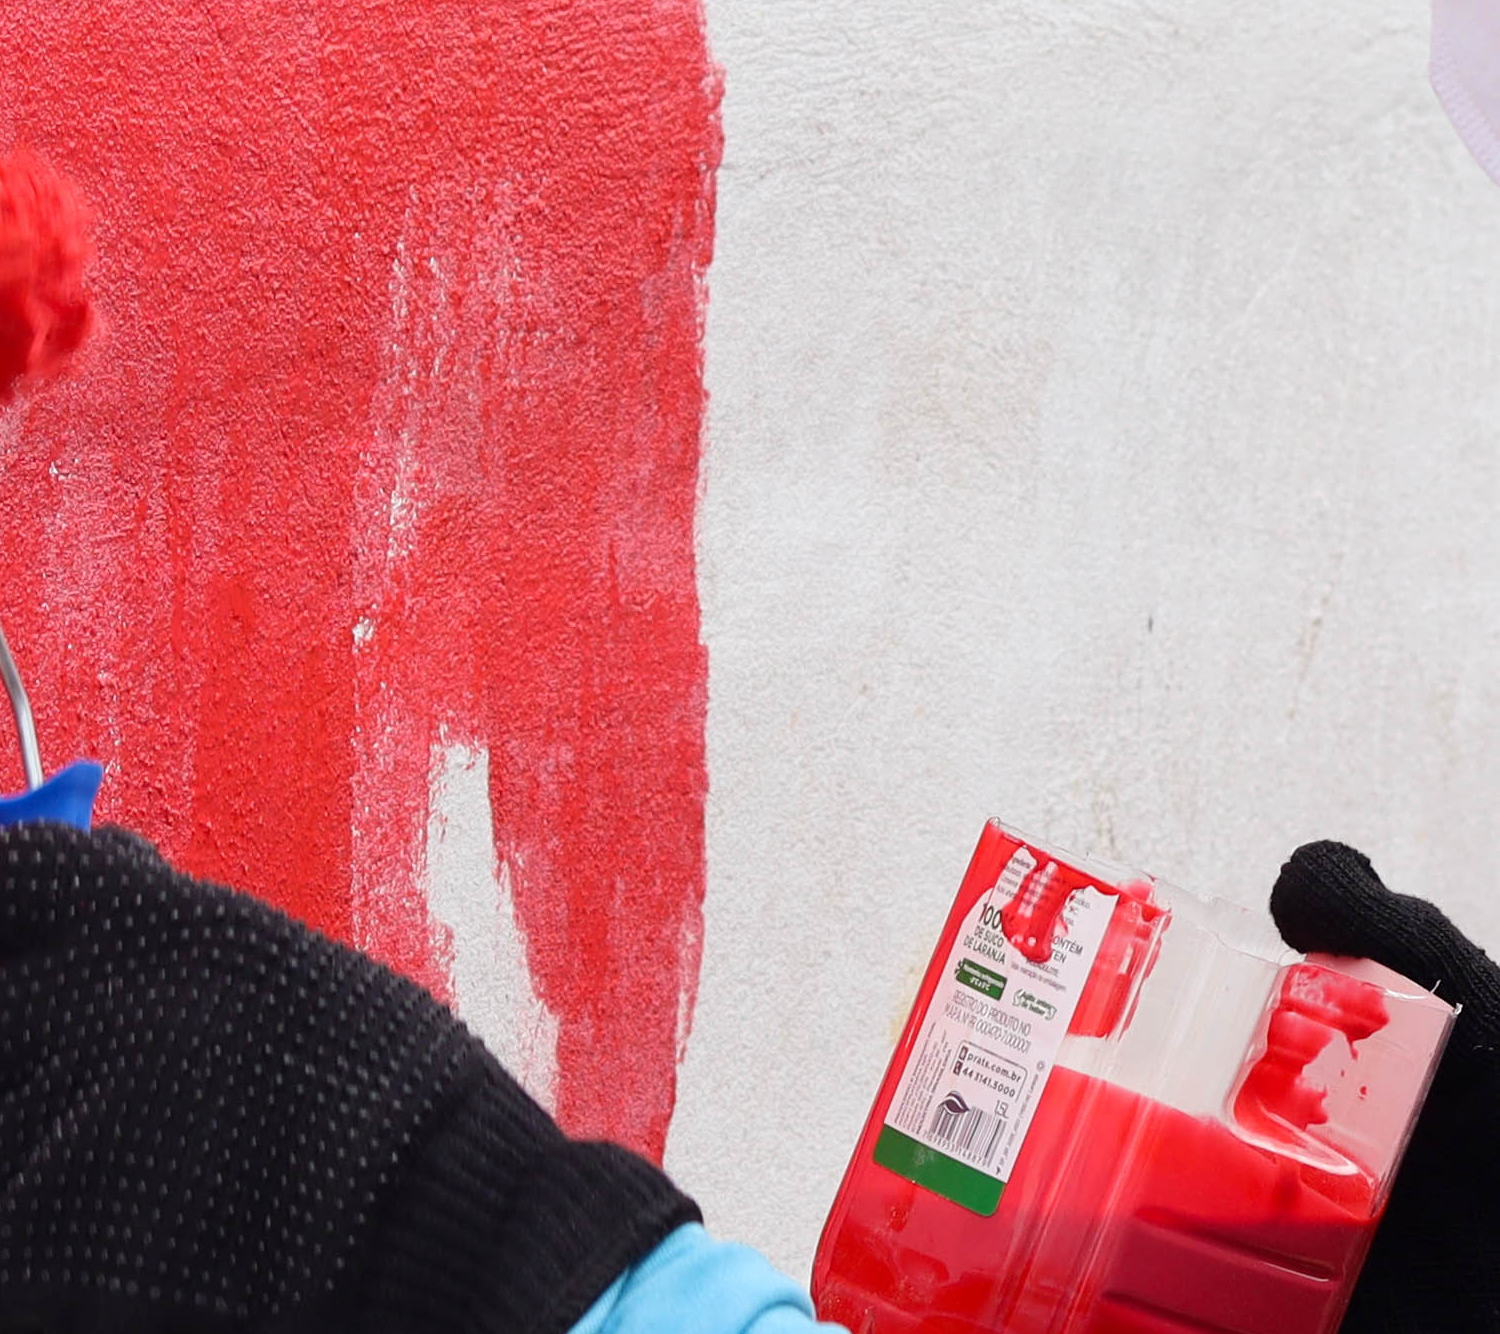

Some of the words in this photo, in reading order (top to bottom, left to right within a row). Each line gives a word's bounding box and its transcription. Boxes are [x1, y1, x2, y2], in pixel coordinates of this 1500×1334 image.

[978, 903, 1006, 934] 100
[963, 935, 973, 948] DE
[972, 938, 1007, 965] LARANJA
[974, 925, 983, 938] DE
[982, 928, 1005, 948] SUCO
[962, 1065, 975, 1079] 44
[974, 1070, 1016, 1098] 3141.5000
[967, 1051, 1023, 1083] prats.com.br
